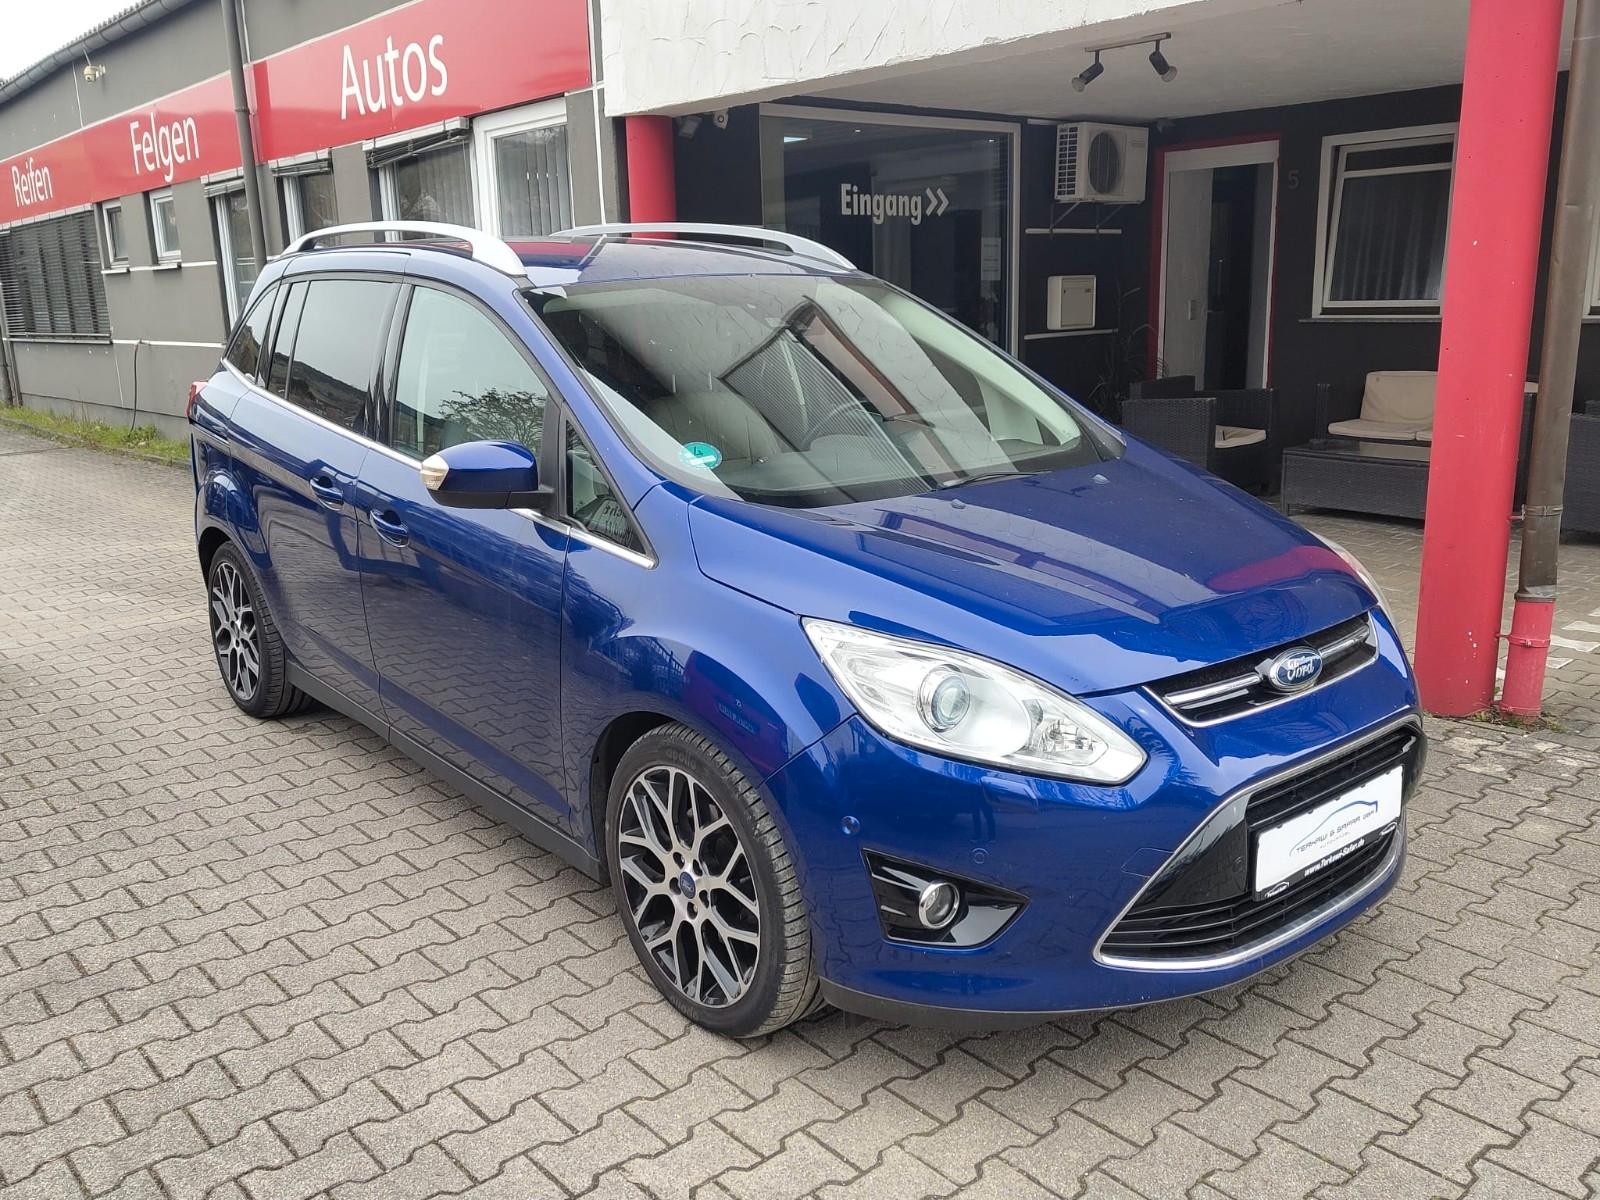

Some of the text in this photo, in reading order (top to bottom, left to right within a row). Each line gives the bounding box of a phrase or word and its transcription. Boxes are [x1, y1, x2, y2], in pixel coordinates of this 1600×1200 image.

[340, 33, 448, 120] Autos
[129, 112, 200, 184] Felgen
[11, 157, 53, 207] Reifen
[1287, 168, 1300, 190] 5
[841, 183, 922, 225] Eingang
[1286, 656, 1316, 681] Ford
